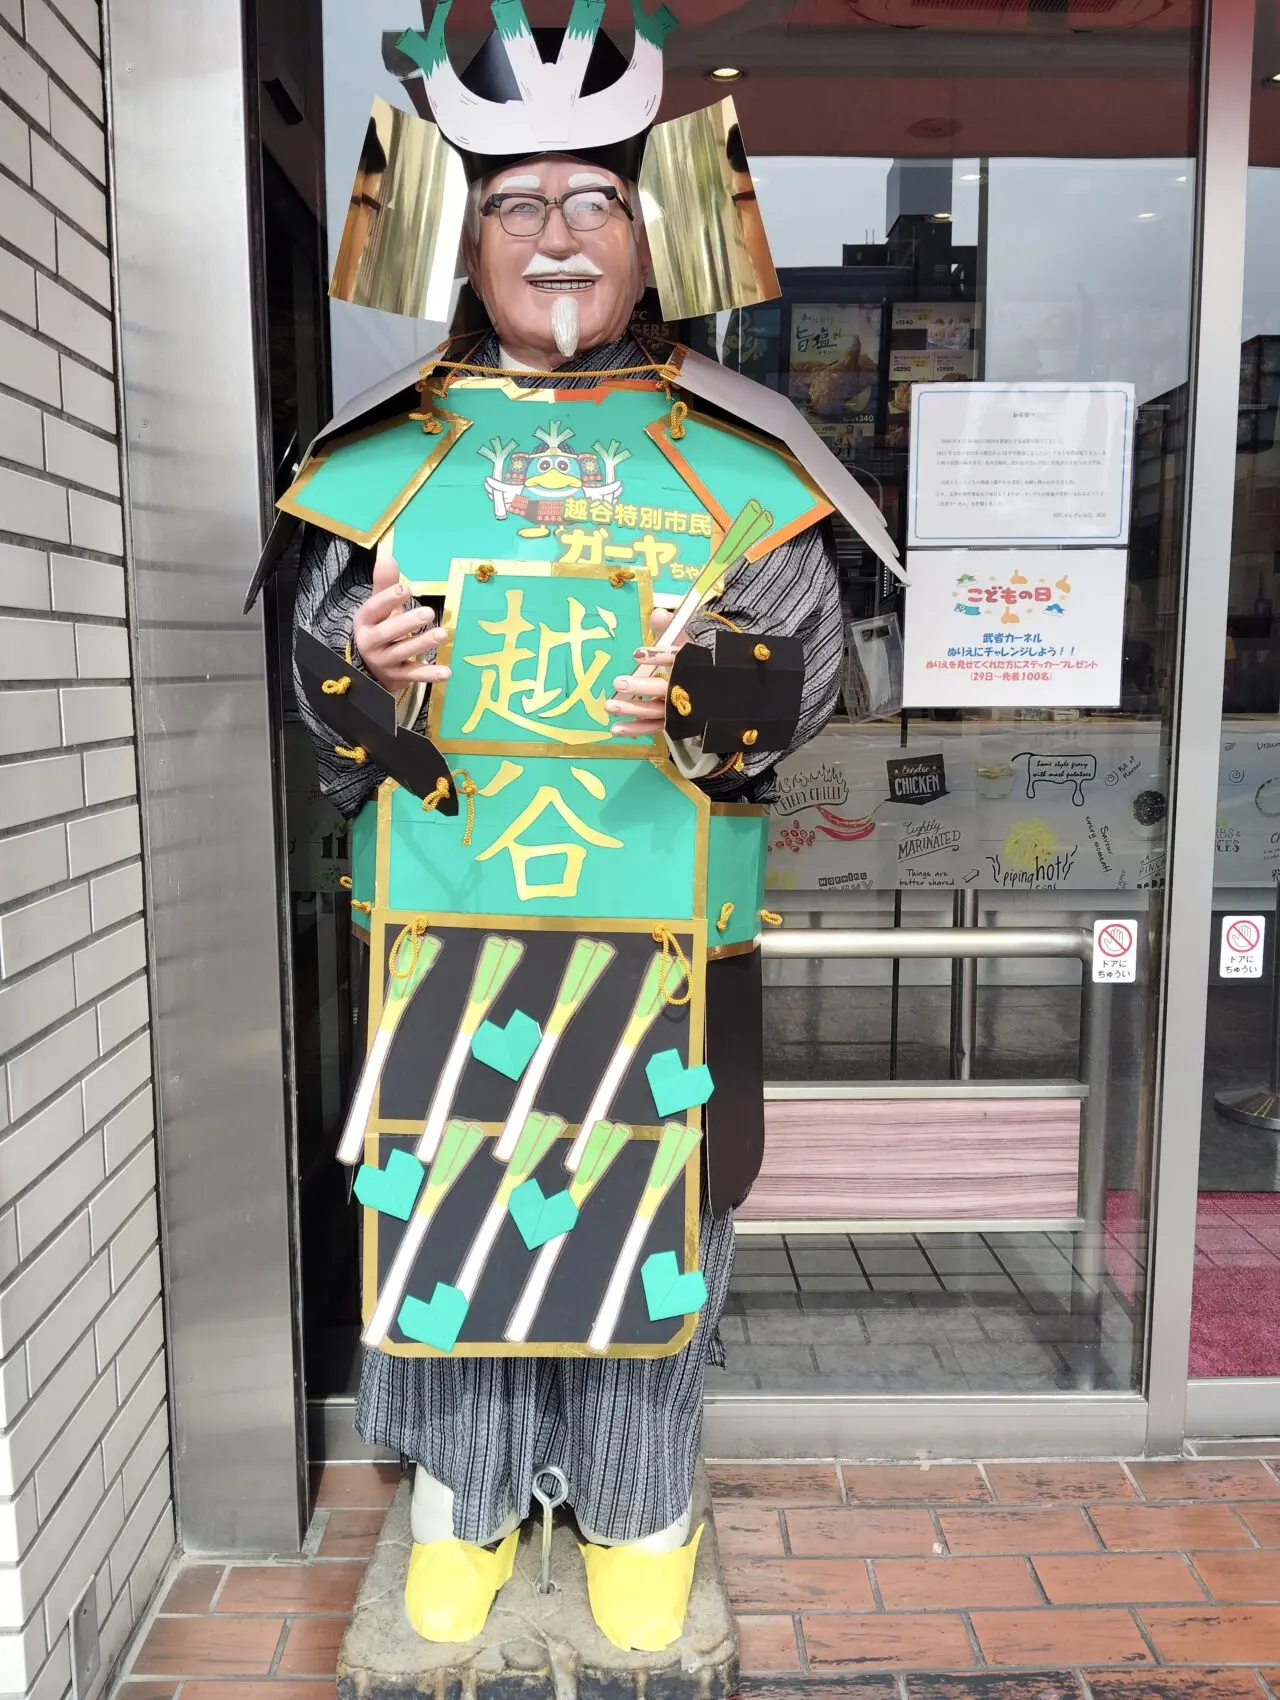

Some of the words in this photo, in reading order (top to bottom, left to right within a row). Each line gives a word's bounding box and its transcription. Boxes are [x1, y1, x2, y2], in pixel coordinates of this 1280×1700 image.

[631, 310, 648, 321] FC
[630, 323, 670, 337] GERS
[563, 498, 713, 537] 越谷特別市民
[558, 528, 704, 581] ガーヤちゃ
[967, 585, 1052, 605] こどもの日
[982, 632, 1043, 643] 武者カーネル
[894, 774, 941, 796] CHICKEN
[898, 829, 961, 860] MARINATED
[1215, 839, 1240, 853] CES
[906, 868, 932, 879] Things
[1035, 856, 1062, 881] hot
[1102, 960, 1127, 968] ドアに
[1230, 955, 1254, 964] ドアに
[1098, 970, 1131, 979] ちゅうい
[1225, 965, 1258, 974] ちゅうい
